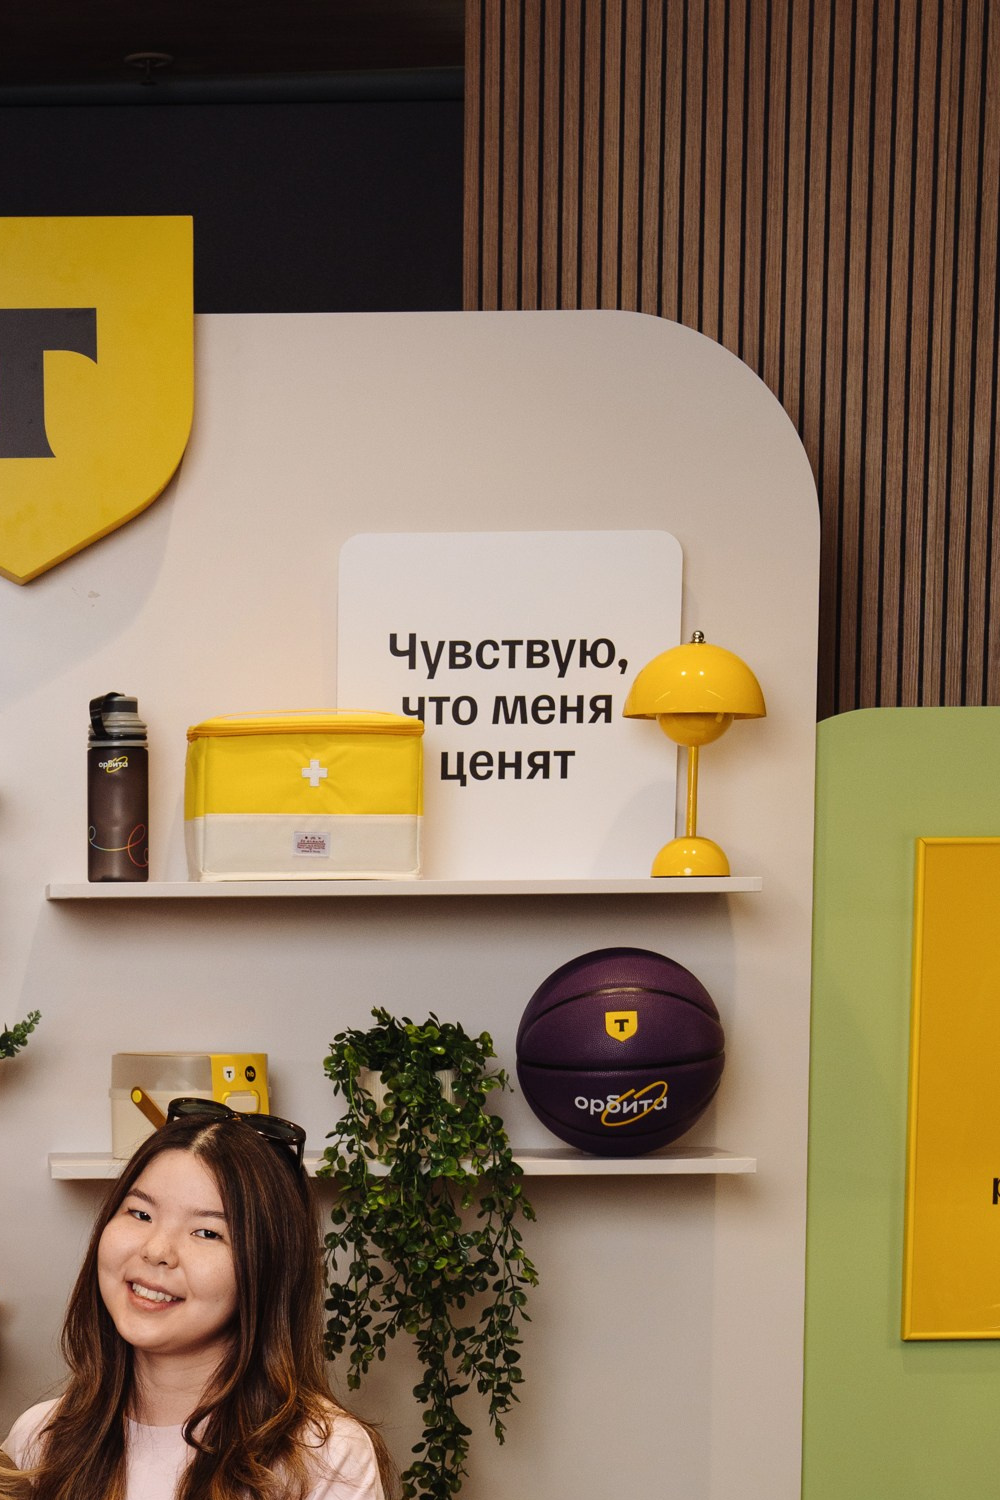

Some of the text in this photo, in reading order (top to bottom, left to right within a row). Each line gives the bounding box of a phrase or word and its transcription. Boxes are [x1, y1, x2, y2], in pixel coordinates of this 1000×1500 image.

[389, 633, 628, 679] Чувствую,
[402, 694, 613, 725] что меня
[440, 750, 576, 787] ценят
[574, 1093, 668, 1117] орбита
